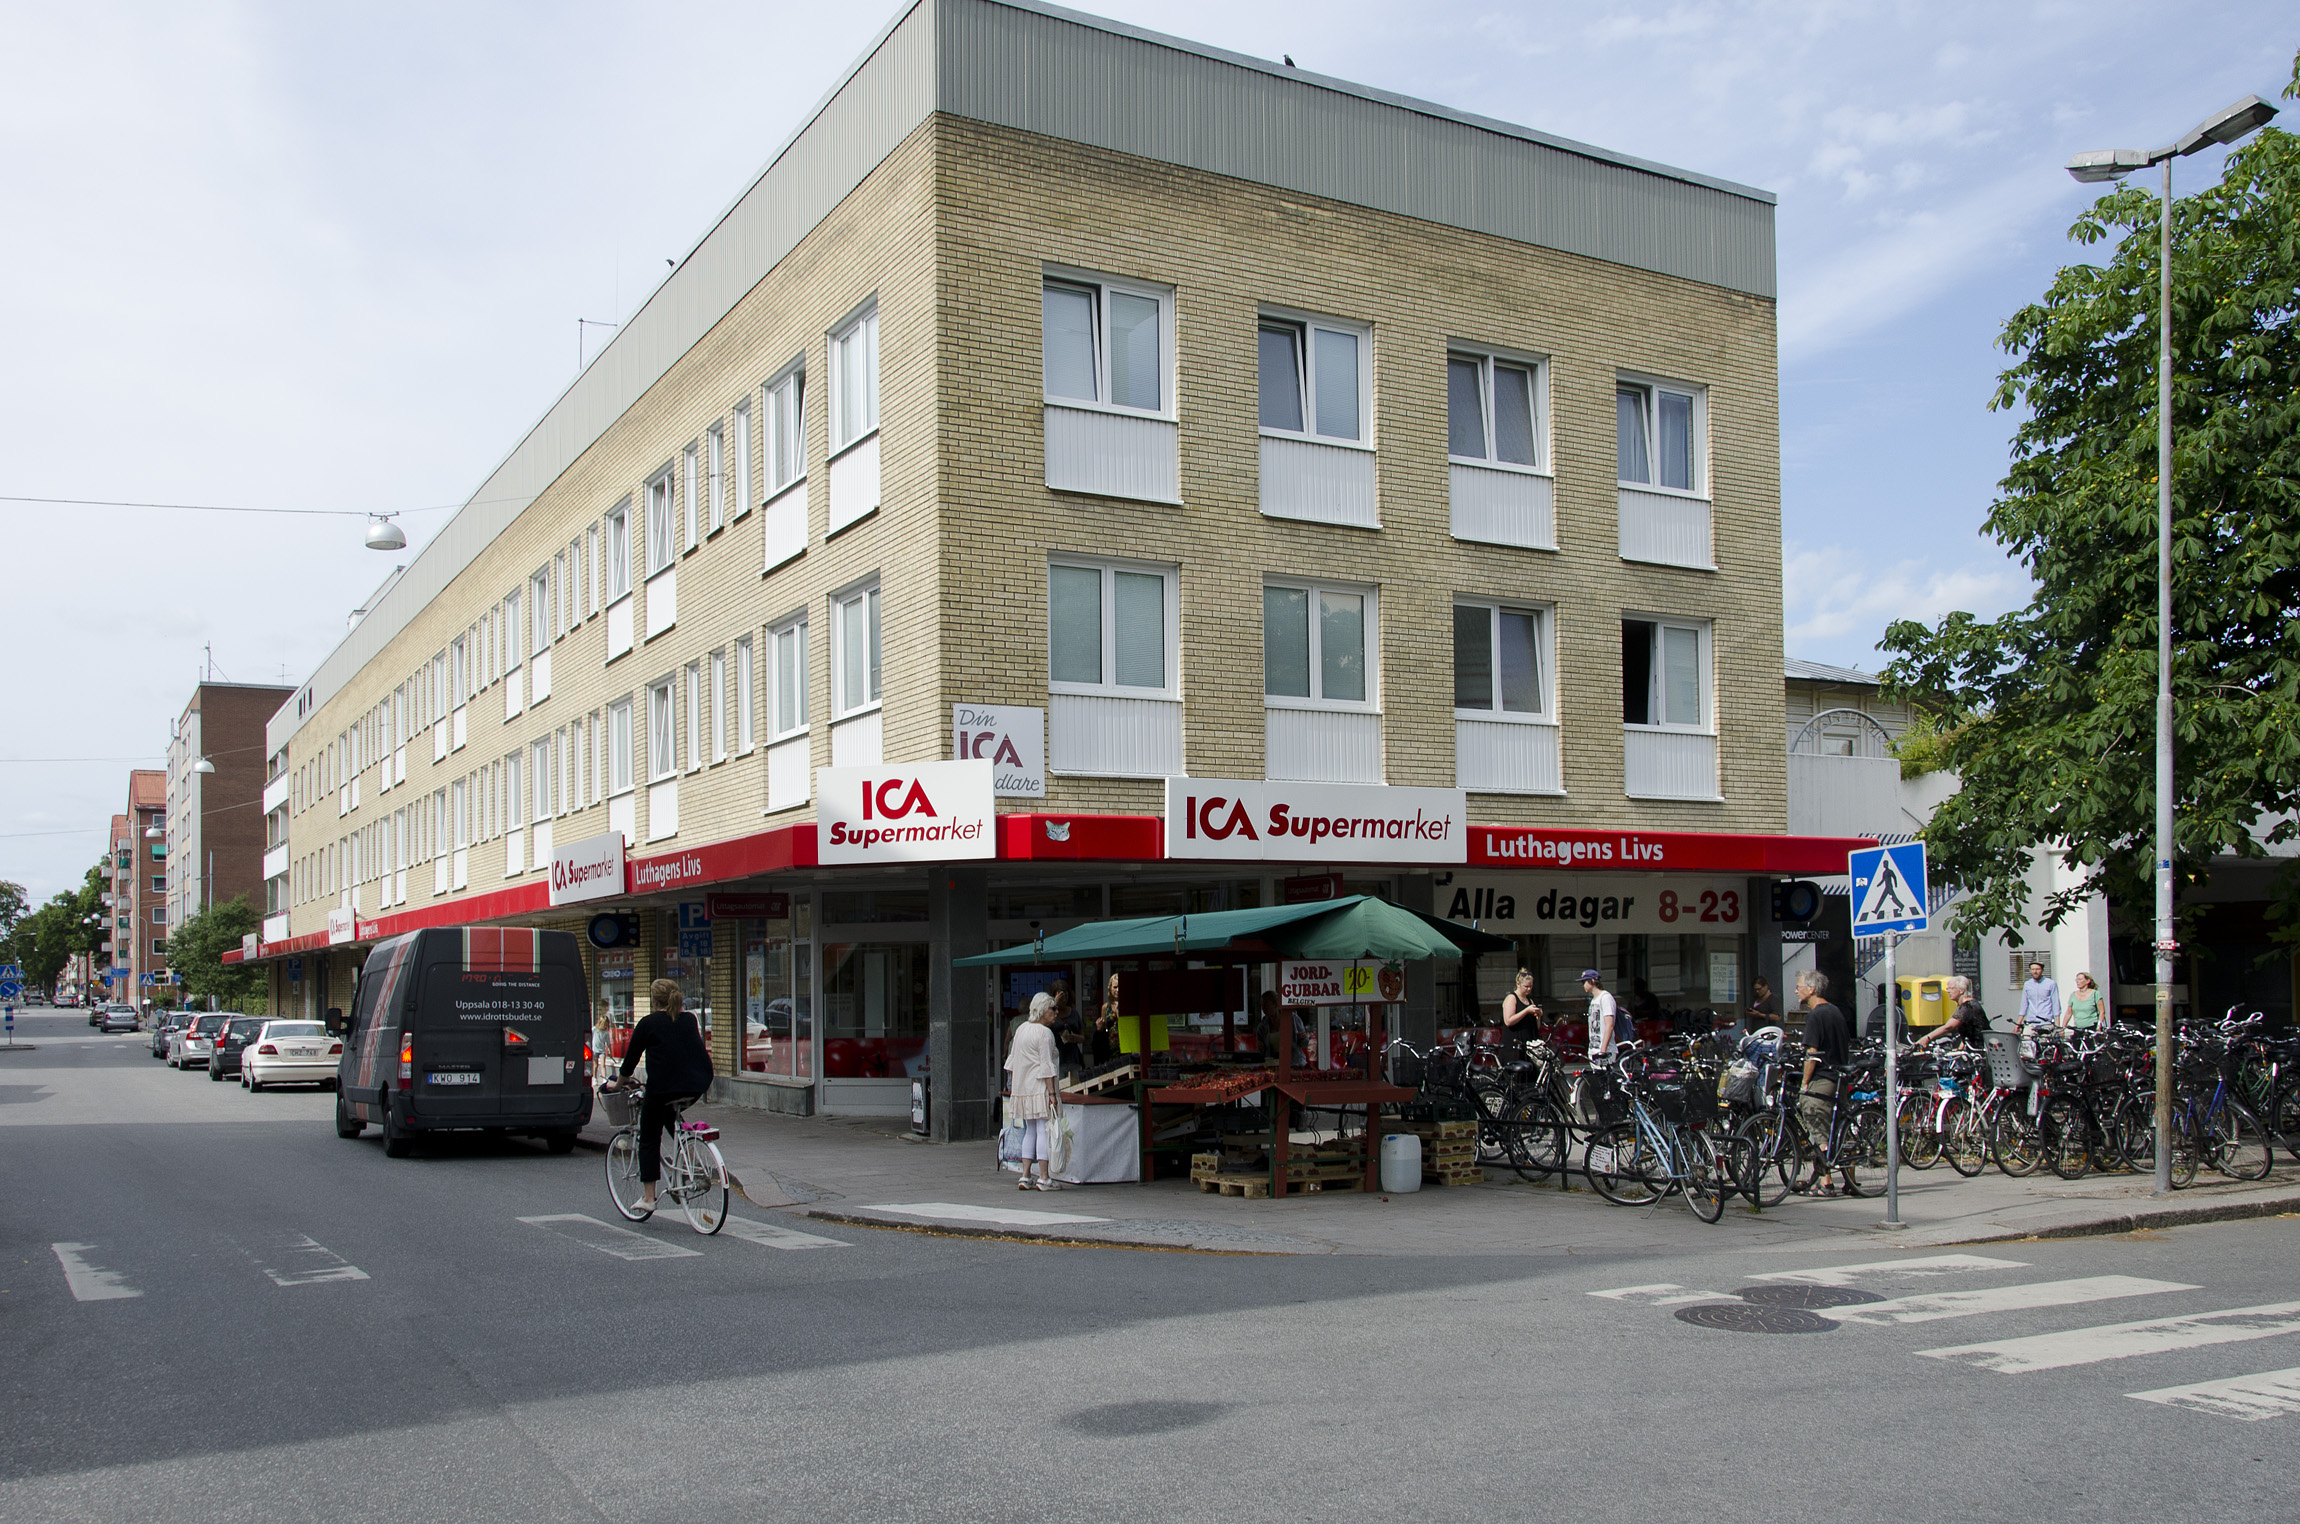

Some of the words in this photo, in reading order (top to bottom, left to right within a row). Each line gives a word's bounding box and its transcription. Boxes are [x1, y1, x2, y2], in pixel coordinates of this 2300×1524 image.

[959, 709, 997, 727] Din
[960, 731, 1024, 768] ICA
[994, 773, 1040, 791] dlare
[862, 777, 938, 820] ICA
[1186, 796, 1260, 841] ICA
[1267, 803, 1452, 844] Supermarket
[829, 816, 983, 849] Supermarket
[1486, 833, 1613, 865] Luthagens
[1620, 836, 1664, 861] Livs
[551, 859, 568, 892] ICA
[568, 851, 614, 888] Supermarket
[635, 860, 681, 887] Luthagens
[682, 853, 702, 878] Livs
[688, 904, 704, 927] P
[1447, 887, 1516, 920] Alla
[1536, 888, 1635, 928] dagar
[1658, 889, 1740, 923] 8-23
[681, 931, 710, 941] Avgift
[1290, 966, 1332, 980] JORD-
[1282, 982, 1341, 998] GUBBAR
[455, 1000, 490, 1010] Uppsala
[491, 1000, 521, 1009] 018-13
[522, 1001, 533, 1009] 30
[534, 1001, 545, 1010] 40
[1287, 998, 1316, 1006] BELGIEN
[459, 1012, 542, 1022] www.idrottsbudet.se
[459, 1073, 478, 1082] 914
